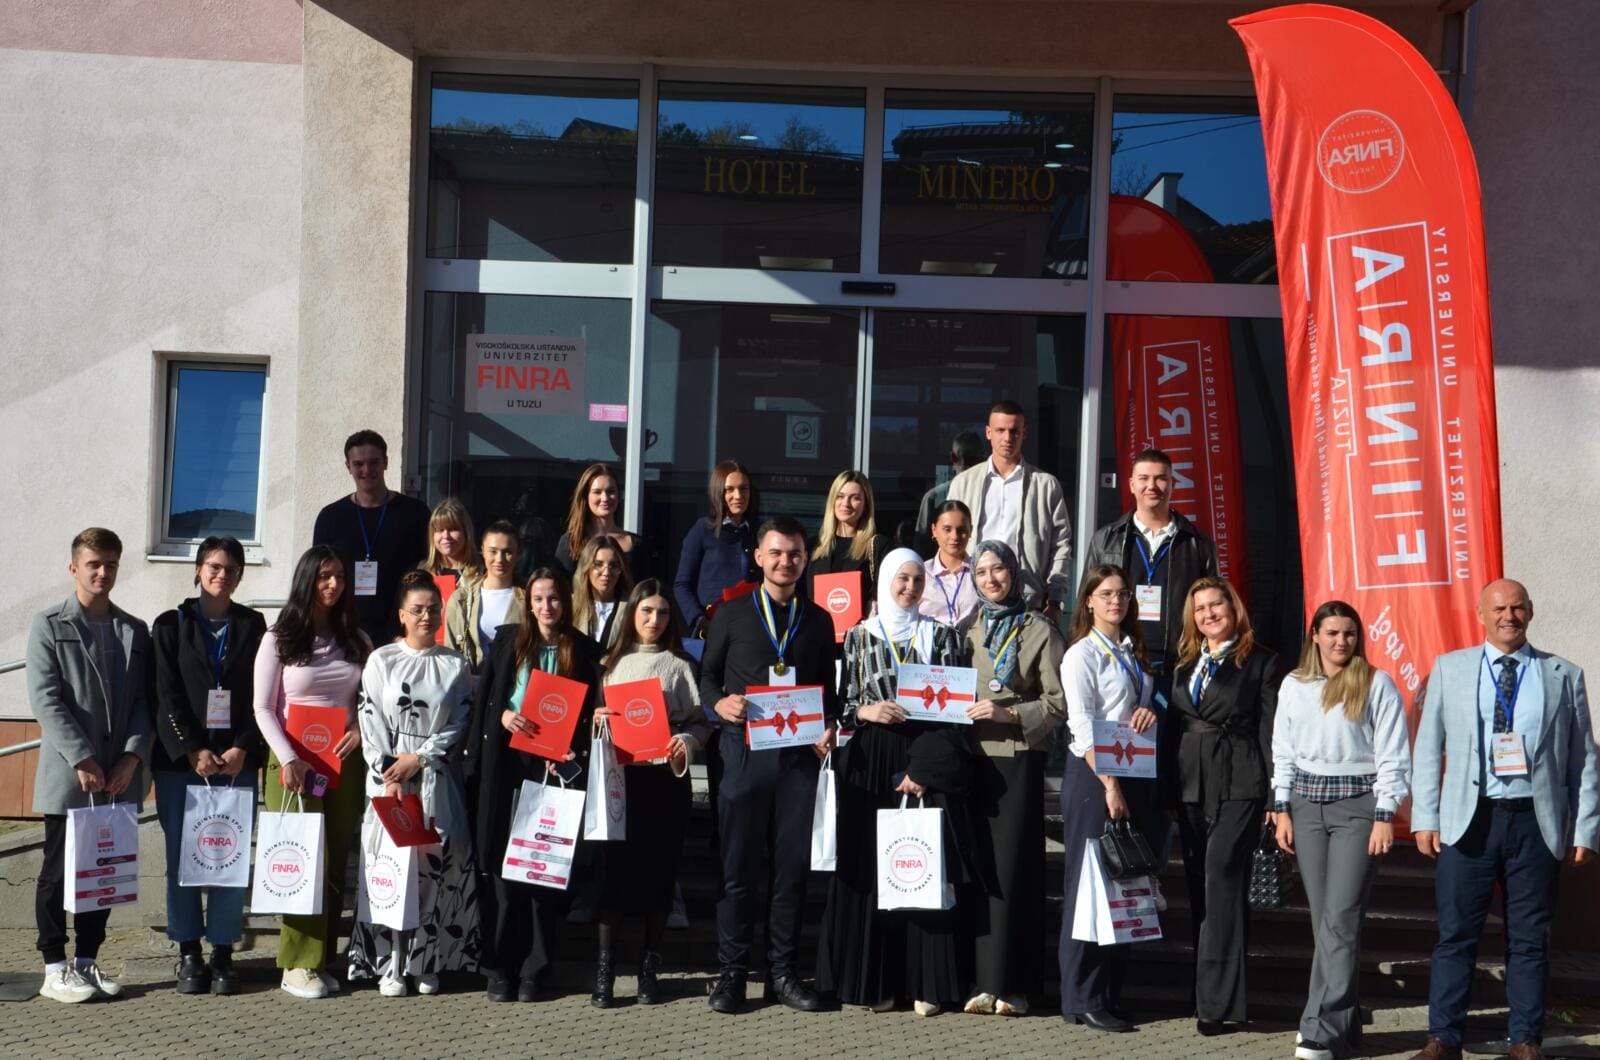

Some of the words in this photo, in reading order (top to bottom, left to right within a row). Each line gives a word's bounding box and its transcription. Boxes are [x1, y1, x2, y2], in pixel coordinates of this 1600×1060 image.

[703, 156, 816, 196] HOTEL
[916, 162, 1057, 203] MINERO
[536, 343, 577, 352] USTANOVA
[484, 351, 569, 362] UNIVERZITET
[477, 365, 572, 392] FINRA
[507, 400, 514, 408] U
[516, 400, 542, 409] TUZLI
[829, 597, 848, 605] FINRA
[542, 702, 564, 714] FINRA
[627, 708, 651, 718] FINRA
[305, 734, 328, 743] FINRA
[192, 814, 230, 832] JEDINSTVEN
[203, 837, 232, 847] FINRA
[272, 863, 300, 873] FINRA
[895, 859, 923, 869] FINRA
[371, 876, 393, 888] FINRA
